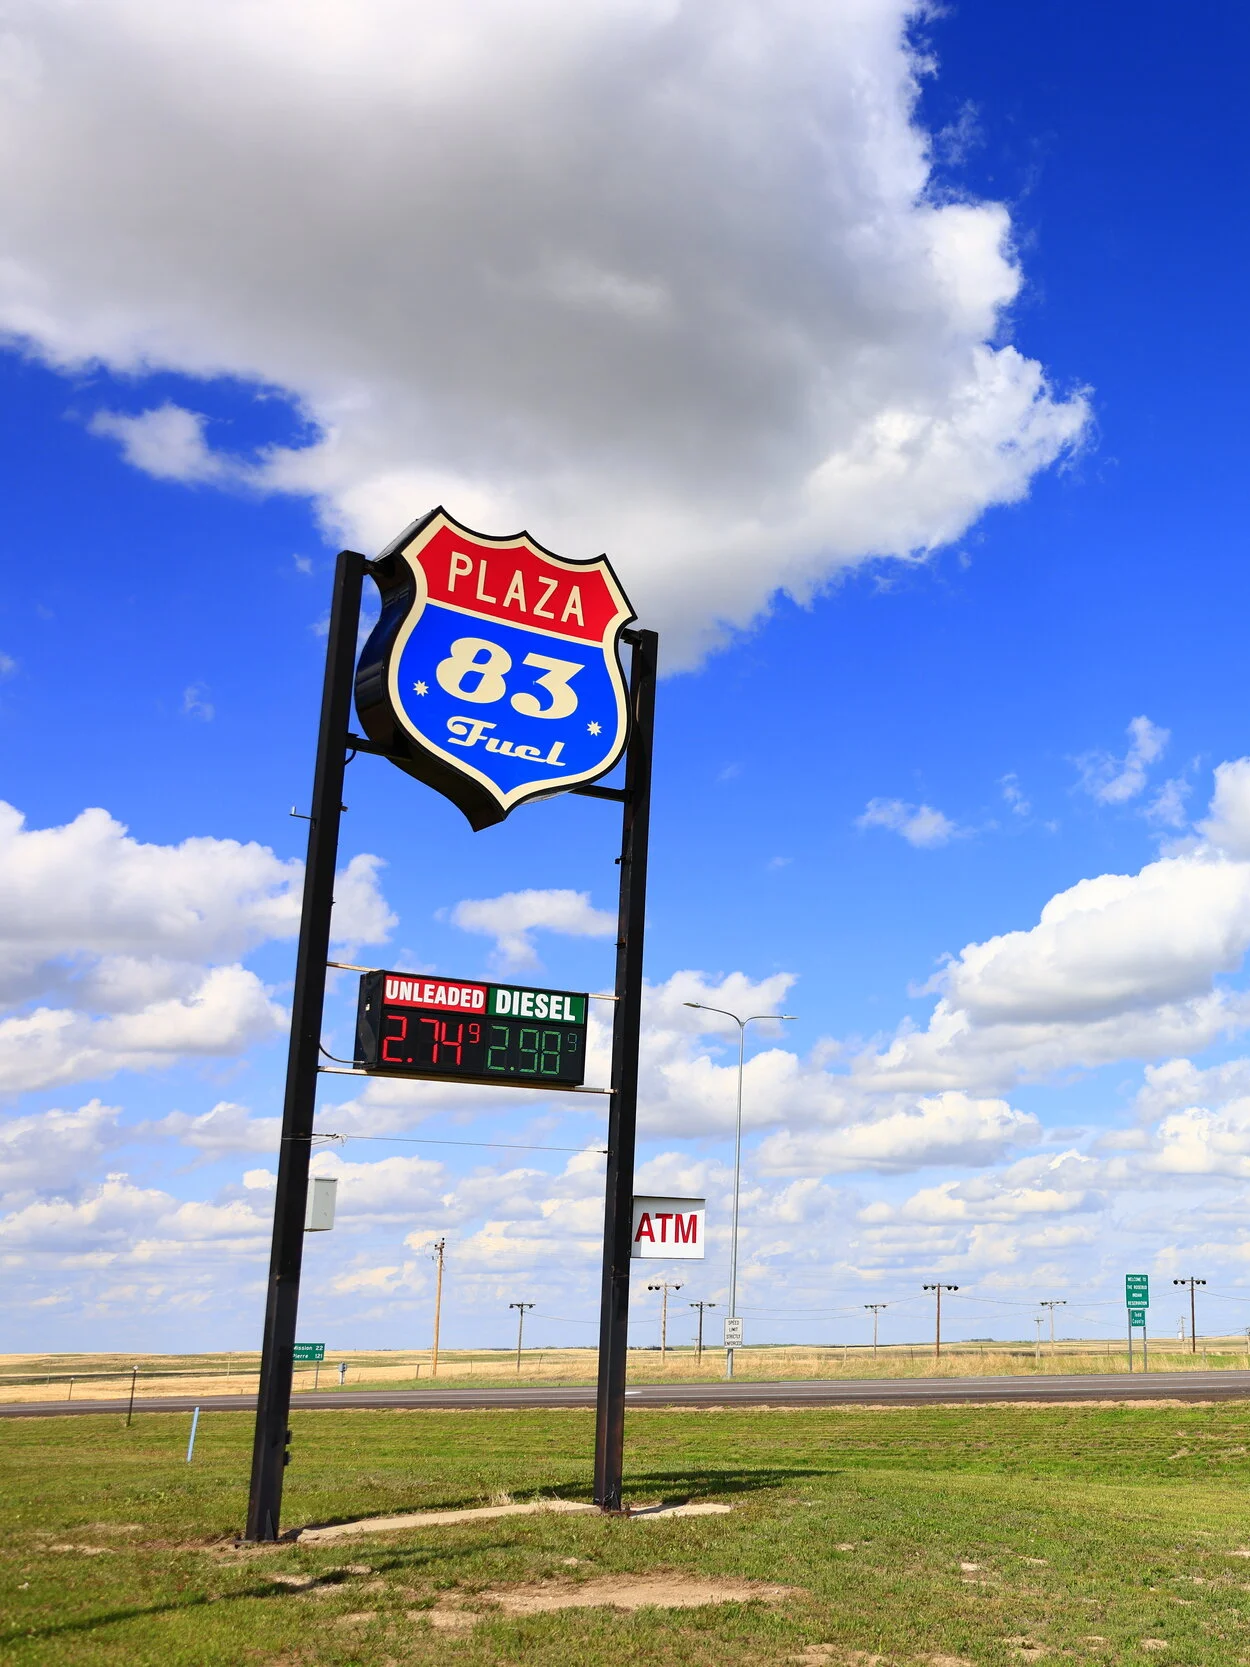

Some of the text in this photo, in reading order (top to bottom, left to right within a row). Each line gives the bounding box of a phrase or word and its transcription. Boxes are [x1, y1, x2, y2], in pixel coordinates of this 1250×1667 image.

[447, 550, 585, 627] PLAZA
[435, 636, 586, 720] 83
[446, 715, 567, 767] Fuel
[385, 979, 485, 1009] UNLEADED
[495, 989, 576, 1022] DIESEL
[634, 1212, 698, 1244] ATM
